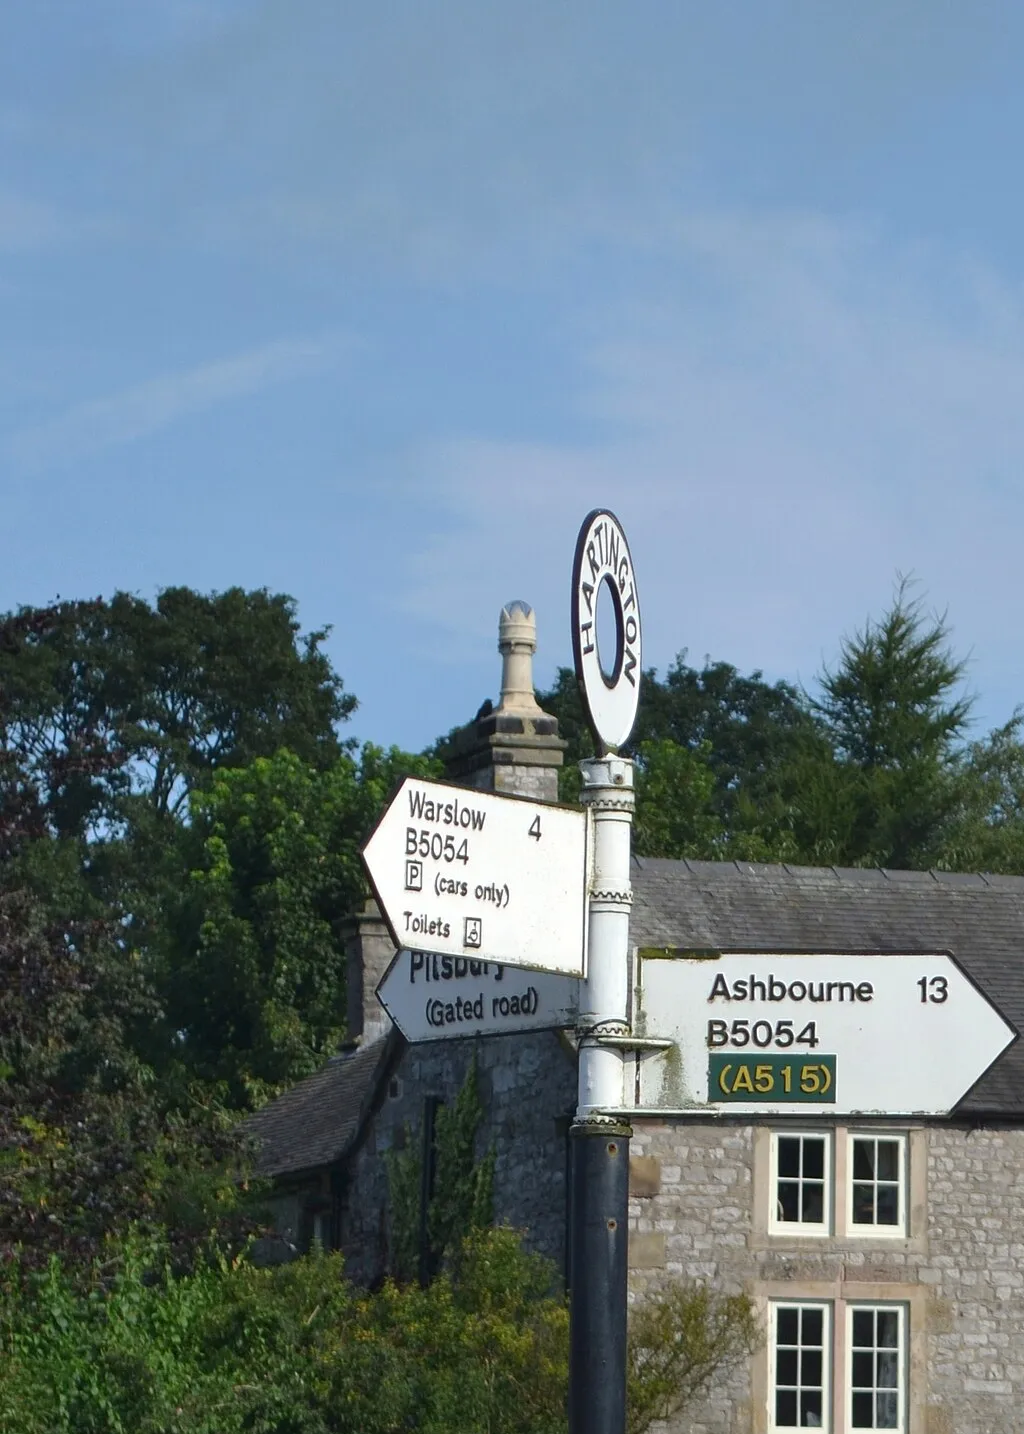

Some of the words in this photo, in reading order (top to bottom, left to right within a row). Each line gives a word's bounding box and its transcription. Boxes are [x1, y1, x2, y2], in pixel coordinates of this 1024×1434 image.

[581, 522, 637, 688] HARTINGTON
[408, 790, 486, 831] Warslow
[528, 814, 542, 842] 4
[405, 827, 470, 866] B5054
[434, 872, 468, 896] (cars
[474, 882, 510, 908] only)
[403, 911, 451, 938] Toilets
[707, 973, 874, 1003] Ashbourne
[917, 976, 949, 1003] 13
[426, 993, 484, 1027] (Gated
[492, 986, 538, 1017] road)
[707, 1019, 819, 1048] B5054
[718, 1063, 832, 1094] (A515)
